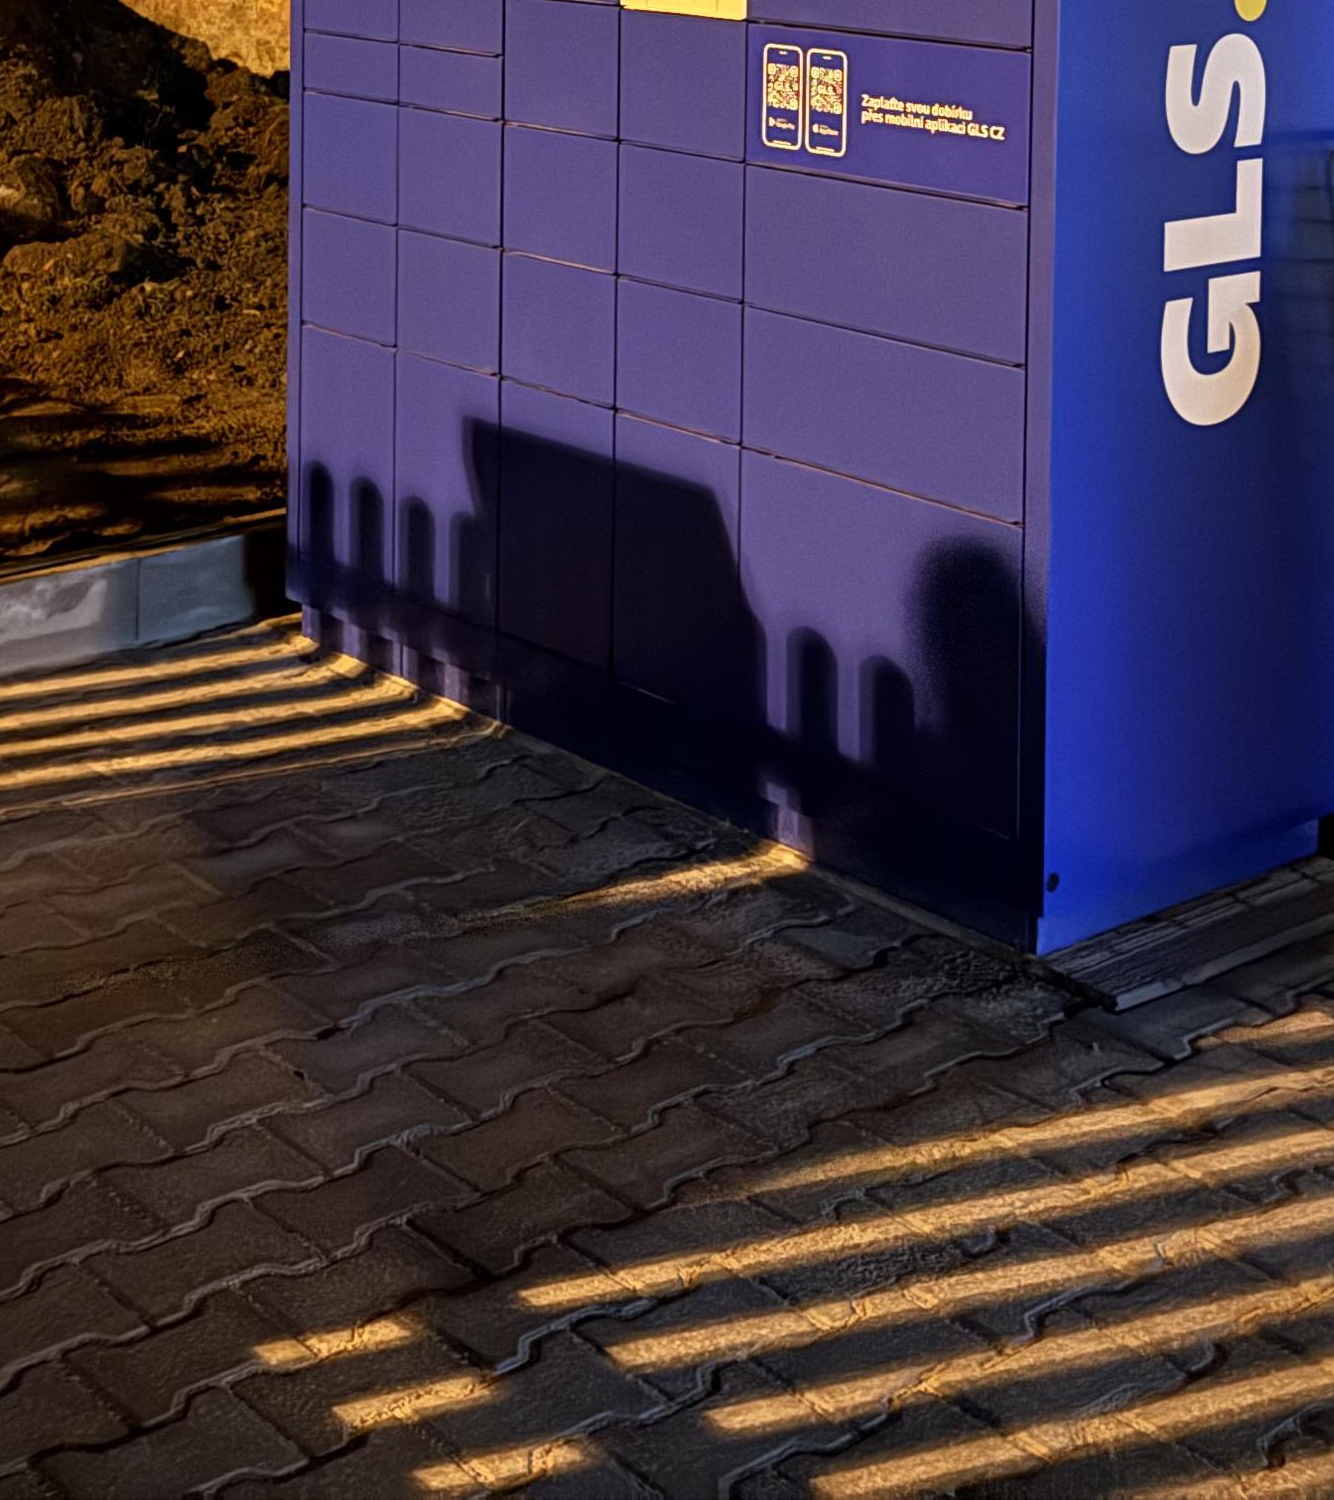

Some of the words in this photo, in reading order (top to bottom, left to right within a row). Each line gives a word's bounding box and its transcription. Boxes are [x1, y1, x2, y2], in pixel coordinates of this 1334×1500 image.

[906, 102, 931, 115] svou
[931, 103, 973, 121] dobírku
[861, 109, 884, 124] přes
[885, 111, 924, 129] mobilní
[925, 118, 966, 134] aplikaci
[967, 122, 989, 138] GLS
[990, 126, 1006, 141] CZ
